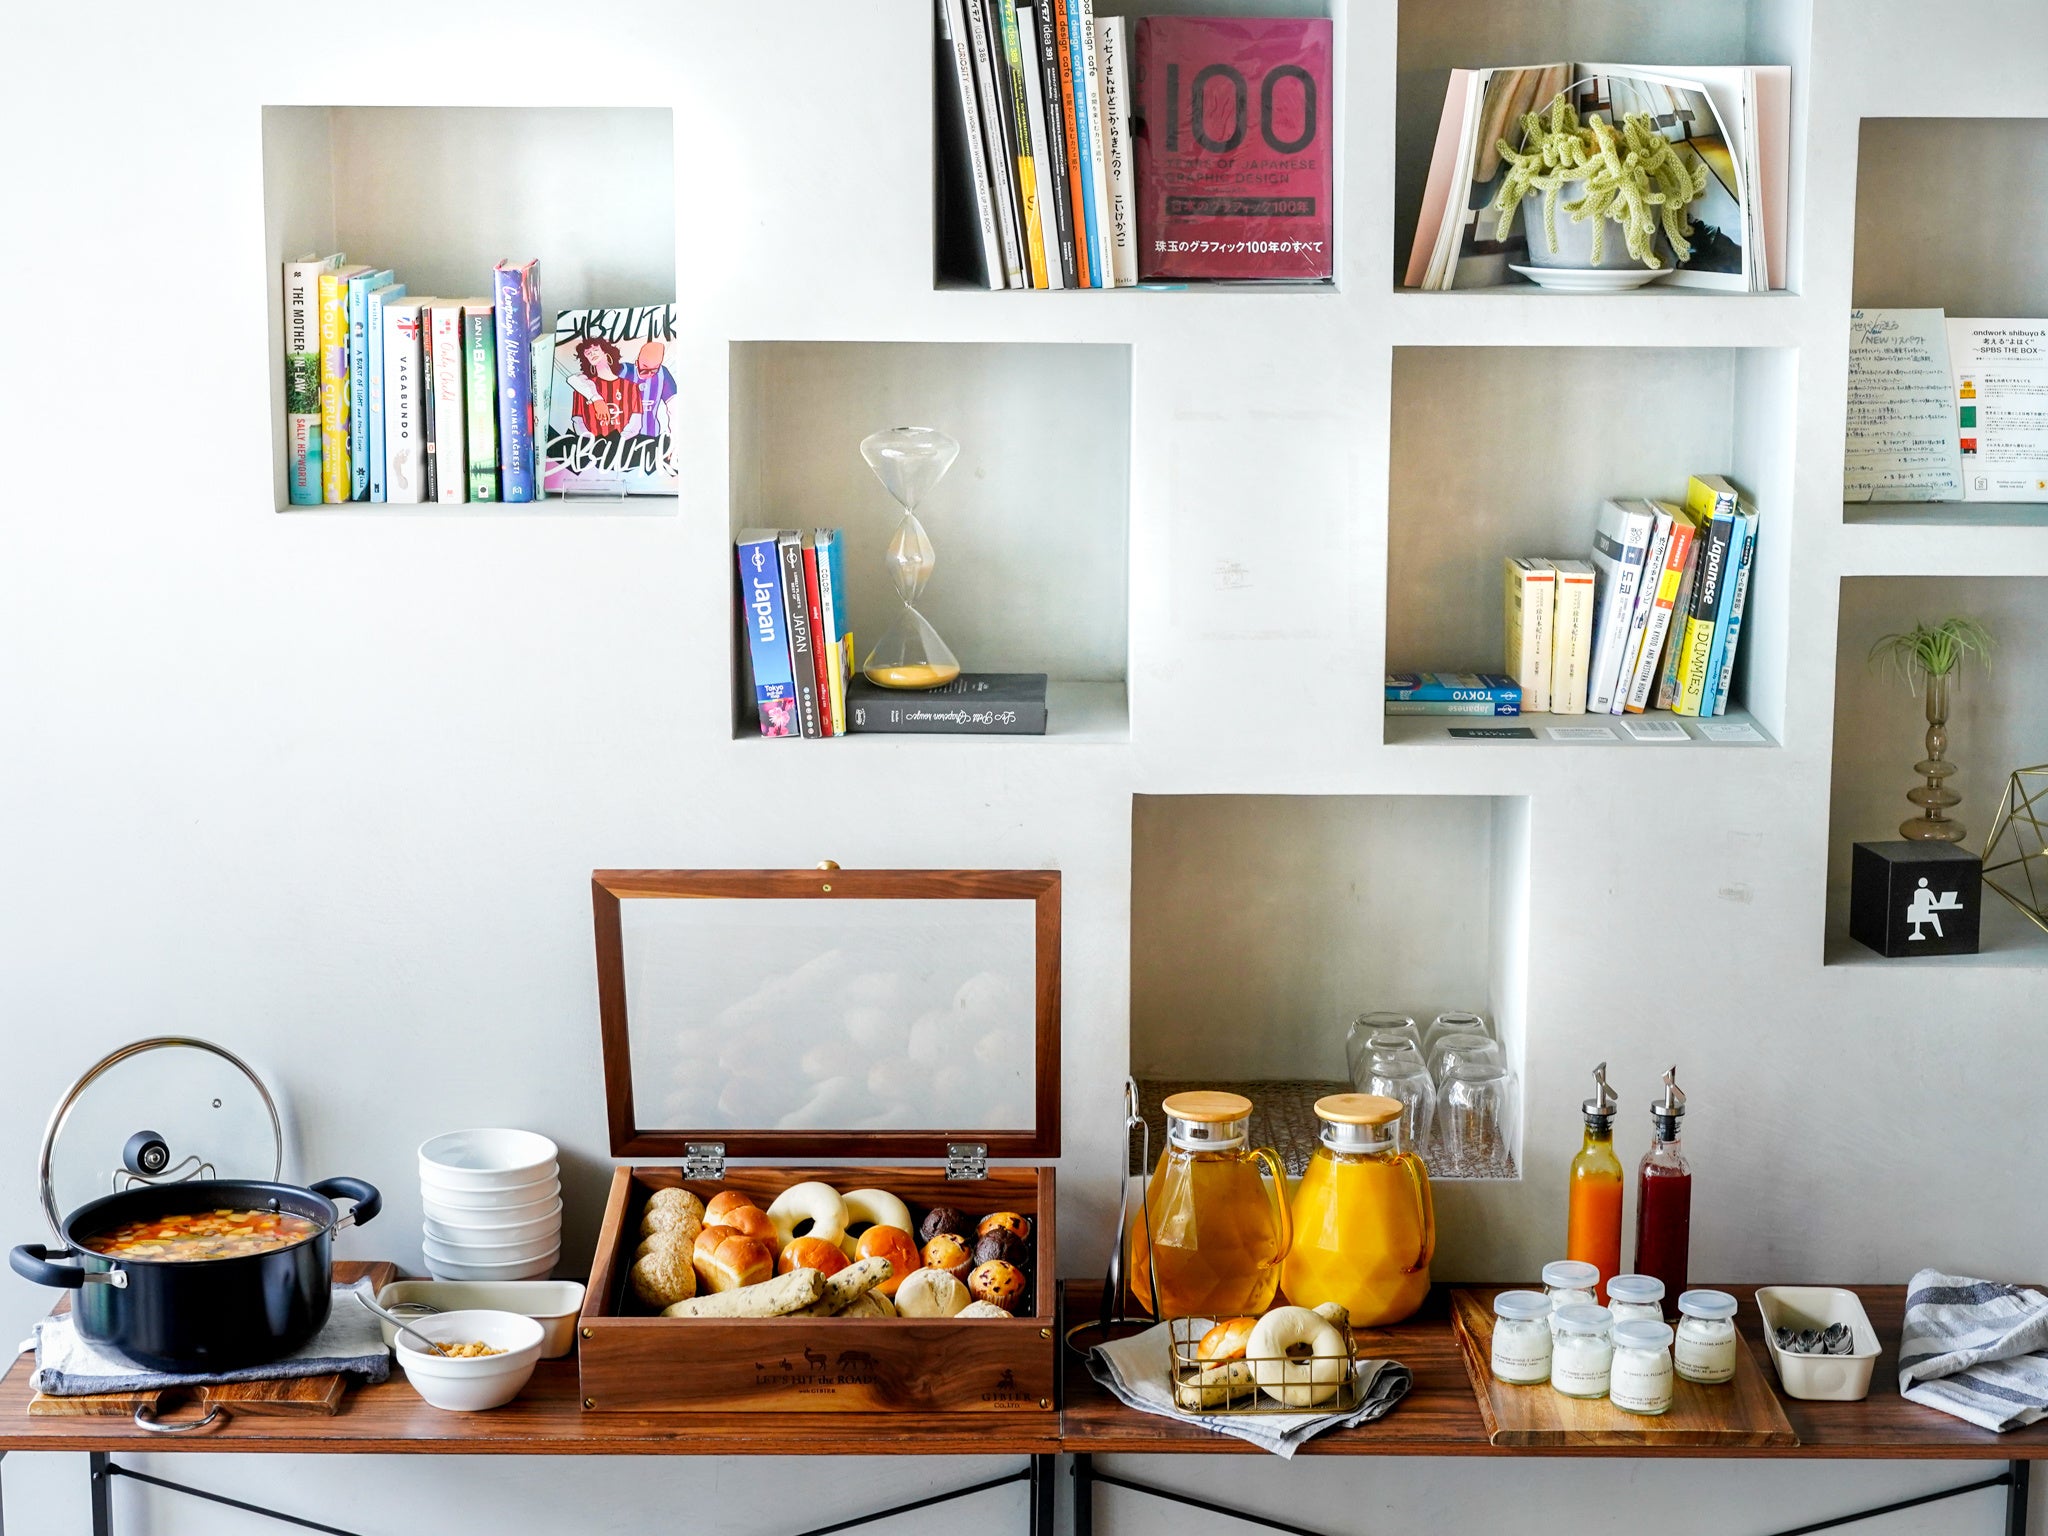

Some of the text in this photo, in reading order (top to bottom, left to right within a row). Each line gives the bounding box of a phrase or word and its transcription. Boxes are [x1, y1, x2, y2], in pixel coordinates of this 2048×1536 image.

[971, 0, 982, 23] イデア
[1004, 0, 1014, 23] イデア
[1041, 0, 1051, 23] イデア
[975, 24, 987, 63] idea 385
[1008, 25, 1019, 63] idea 389
[1043, 24, 1054, 61] idea 391
[1058, 0, 1072, 78] ood design cafe
[1070, 0, 1083, 77] ood design cafe
[1083, 0, 1098, 77] ood design cafe
[957, 42, 970, 82] CURIOSITY
[964, 85, 973, 105] WANTS
[1104, 27, 1121, 181] イッセイさんはどこからきたの？
[967, 106, 975, 114] TO
[1166, 63, 1317, 154] 100
[969, 115, 978, 133] WORK
[971, 134, 980, 149] WITH
[974, 151, 984, 178] WHOEVER
[1166, 159, 1317, 170] YEARS OF JAPANESE
[978, 180, 987, 195] PICKS
[1165, 172, 1290, 184] GRAPHIC DESIGN
[982, 204, 990, 217] THIS
[1171, 201, 1310, 213] 日本のグラフィック100年
[984, 218, 992, 234] BOOK
[1154, 240, 1324, 254] 珠玉のグラフィック100年のすべて
[474, 317, 483, 336] IAIN
[502, 286, 520, 378] Campaign Widows
[555, 304, 676, 347] SUBCULTUR
[2009, 329, 2039, 337] shibuya
[292, 287, 306, 393] THE MOTHER-IN-LAW
[1866, 336, 1888, 344] NEW
[323, 301, 336, 432] GOLD FAME CITRUS
[440, 342, 455, 370] Only
[357, 379, 364, 388] OF
[440, 372, 456, 402] Child
[474, 349, 487, 413] BANKS
[400, 356, 409, 439] VAGABUNDO
[296, 418, 307, 487] SALLY HEPWORTH
[511, 438, 520, 475] AGRESTI
[545, 432, 678, 478] SUBCULTUR
[1670, 534, 1686, 568] FROMMER'S
[1703, 536, 1726, 605] Japanese
[1619, 570, 1635, 595] 도쿄
[751, 578, 775, 643] Japan
[1654, 612, 1666, 630] TOKYO,
[792, 612, 808, 653] JAPAN
[1649, 631, 1661, 648] KYOTO,
[1646, 648, 1657, 660] AND
[1687, 632, 1709, 696] DUMMIES
[1640, 660, 1653, 682] WESTERN
[764, 684, 784, 692] Tokyo
[1452, 690, 1493, 700] TOKYO
[1634, 683, 1648, 702] HONSHU
[905, 709, 933, 720] rouge
[932, 709, 972, 725] Chaperon
[972, 711, 994, 725] Petit
[1447, 703, 1490, 713] Japanese
[792, 1375, 813, 1385] HIT
[818, 1375, 834, 1385] the
[982, 1392, 1031, 1401] GIBIER
